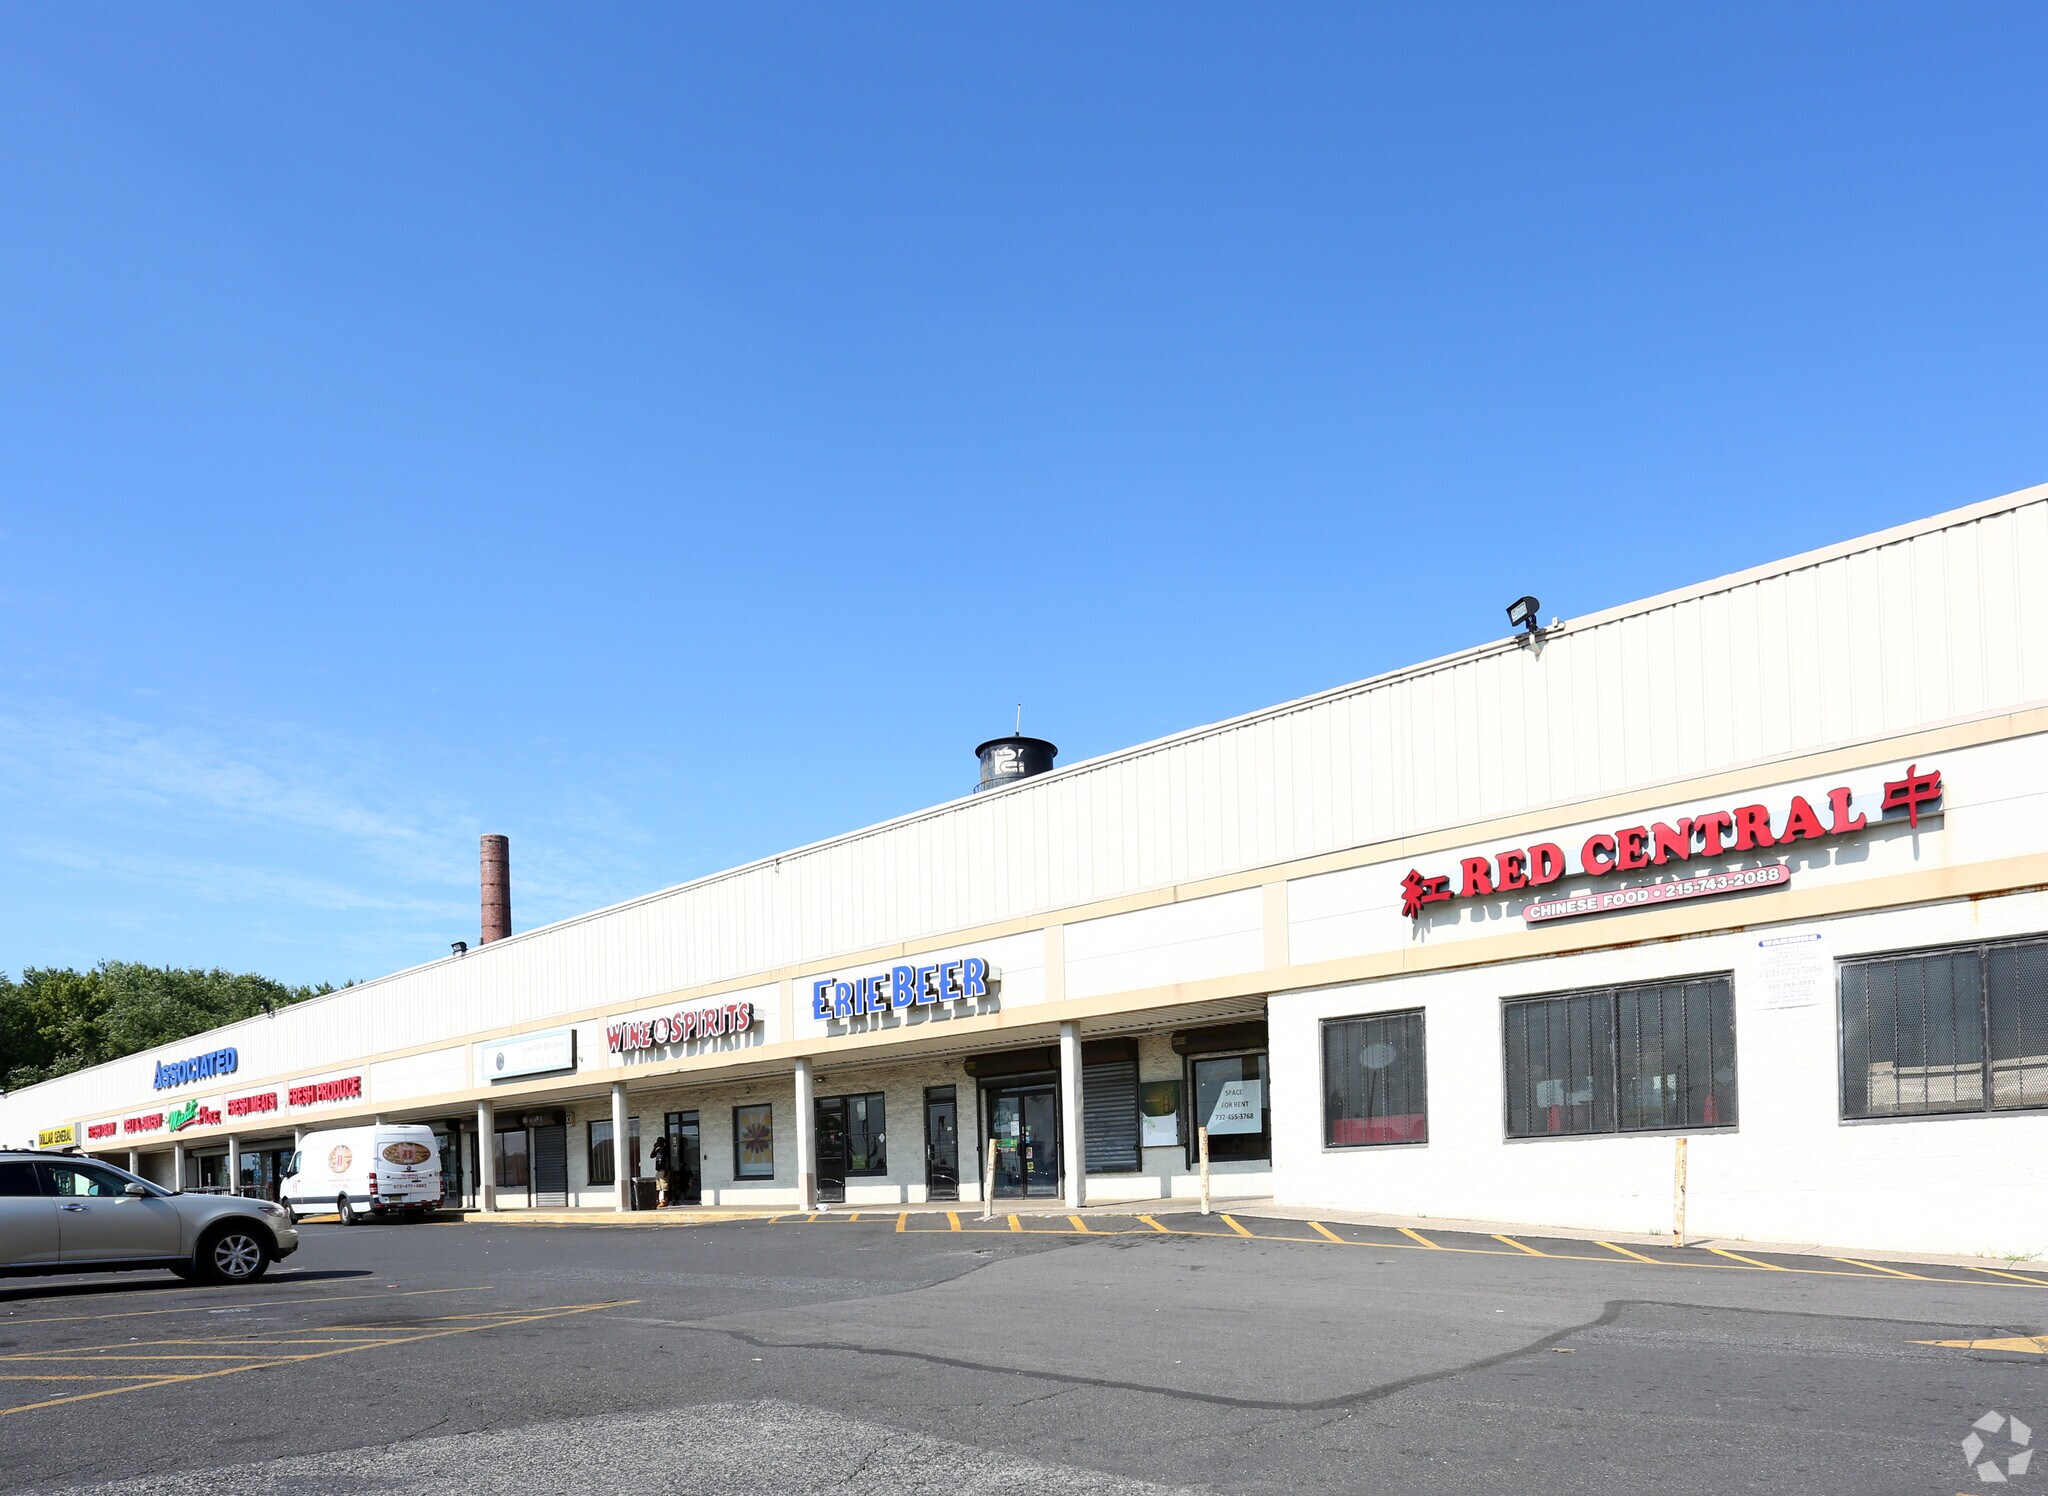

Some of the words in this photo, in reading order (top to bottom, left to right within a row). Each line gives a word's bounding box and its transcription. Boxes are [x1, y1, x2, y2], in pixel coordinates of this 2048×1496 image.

[1881, 764, 1943, 829] 中
[1460, 842, 1565, 897] RED
[1581, 787, 1867, 876] CENTRAL
[1400, 869, 1454, 919] 紅
[1529, 897, 1598, 919] CHINESE
[1603, 889, 1649, 907] FOOD
[1665, 868, 1780, 898] 215-743-2088
[812, 974, 886, 1021] ERIE
[891, 957, 987, 1010] BEER
[606, 1020, 652, 1052] WINE
[671, 1002, 753, 1044] SPIRITS
[153, 1047, 238, 1089] ASSOCIATED
[288, 1084, 316, 1106] FRESH
[317, 1076, 361, 1101] PRODUCE
[228, 1096, 248, 1115] FRESH
[249, 1092, 277, 1112] MEATS
[39, 1132, 53, 1145] DOLLAR
[54, 1129, 72, 1144] GENERAL
